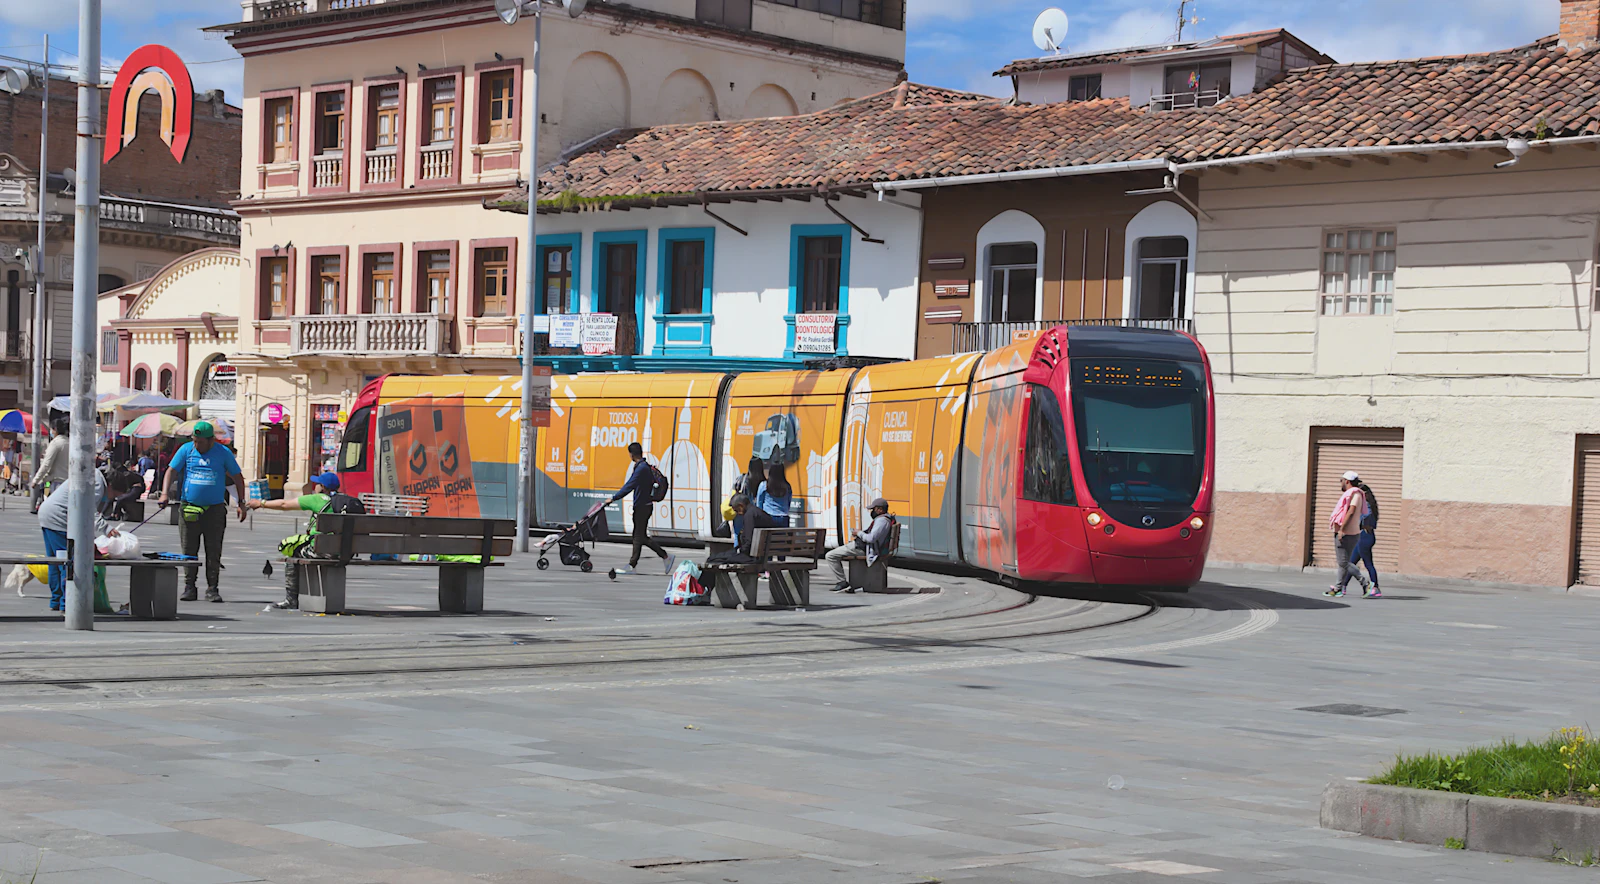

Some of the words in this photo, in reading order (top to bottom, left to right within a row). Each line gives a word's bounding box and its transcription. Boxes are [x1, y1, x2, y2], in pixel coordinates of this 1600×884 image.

[604, 316, 616, 324] LOCAL
[798, 315, 834, 323] CONSULTORIO
[387, 419, 397, 429] 50
[397, 418, 405, 429] kg
[609, 412, 633, 424] TODOS
[633, 412, 639, 424] A
[884, 411, 908, 428] CUENCA
[590, 426, 638, 447] BORDO
[882, 431, 889, 442] NO
[889, 431, 895, 442] SE
[895, 430, 912, 442] DETIENE
